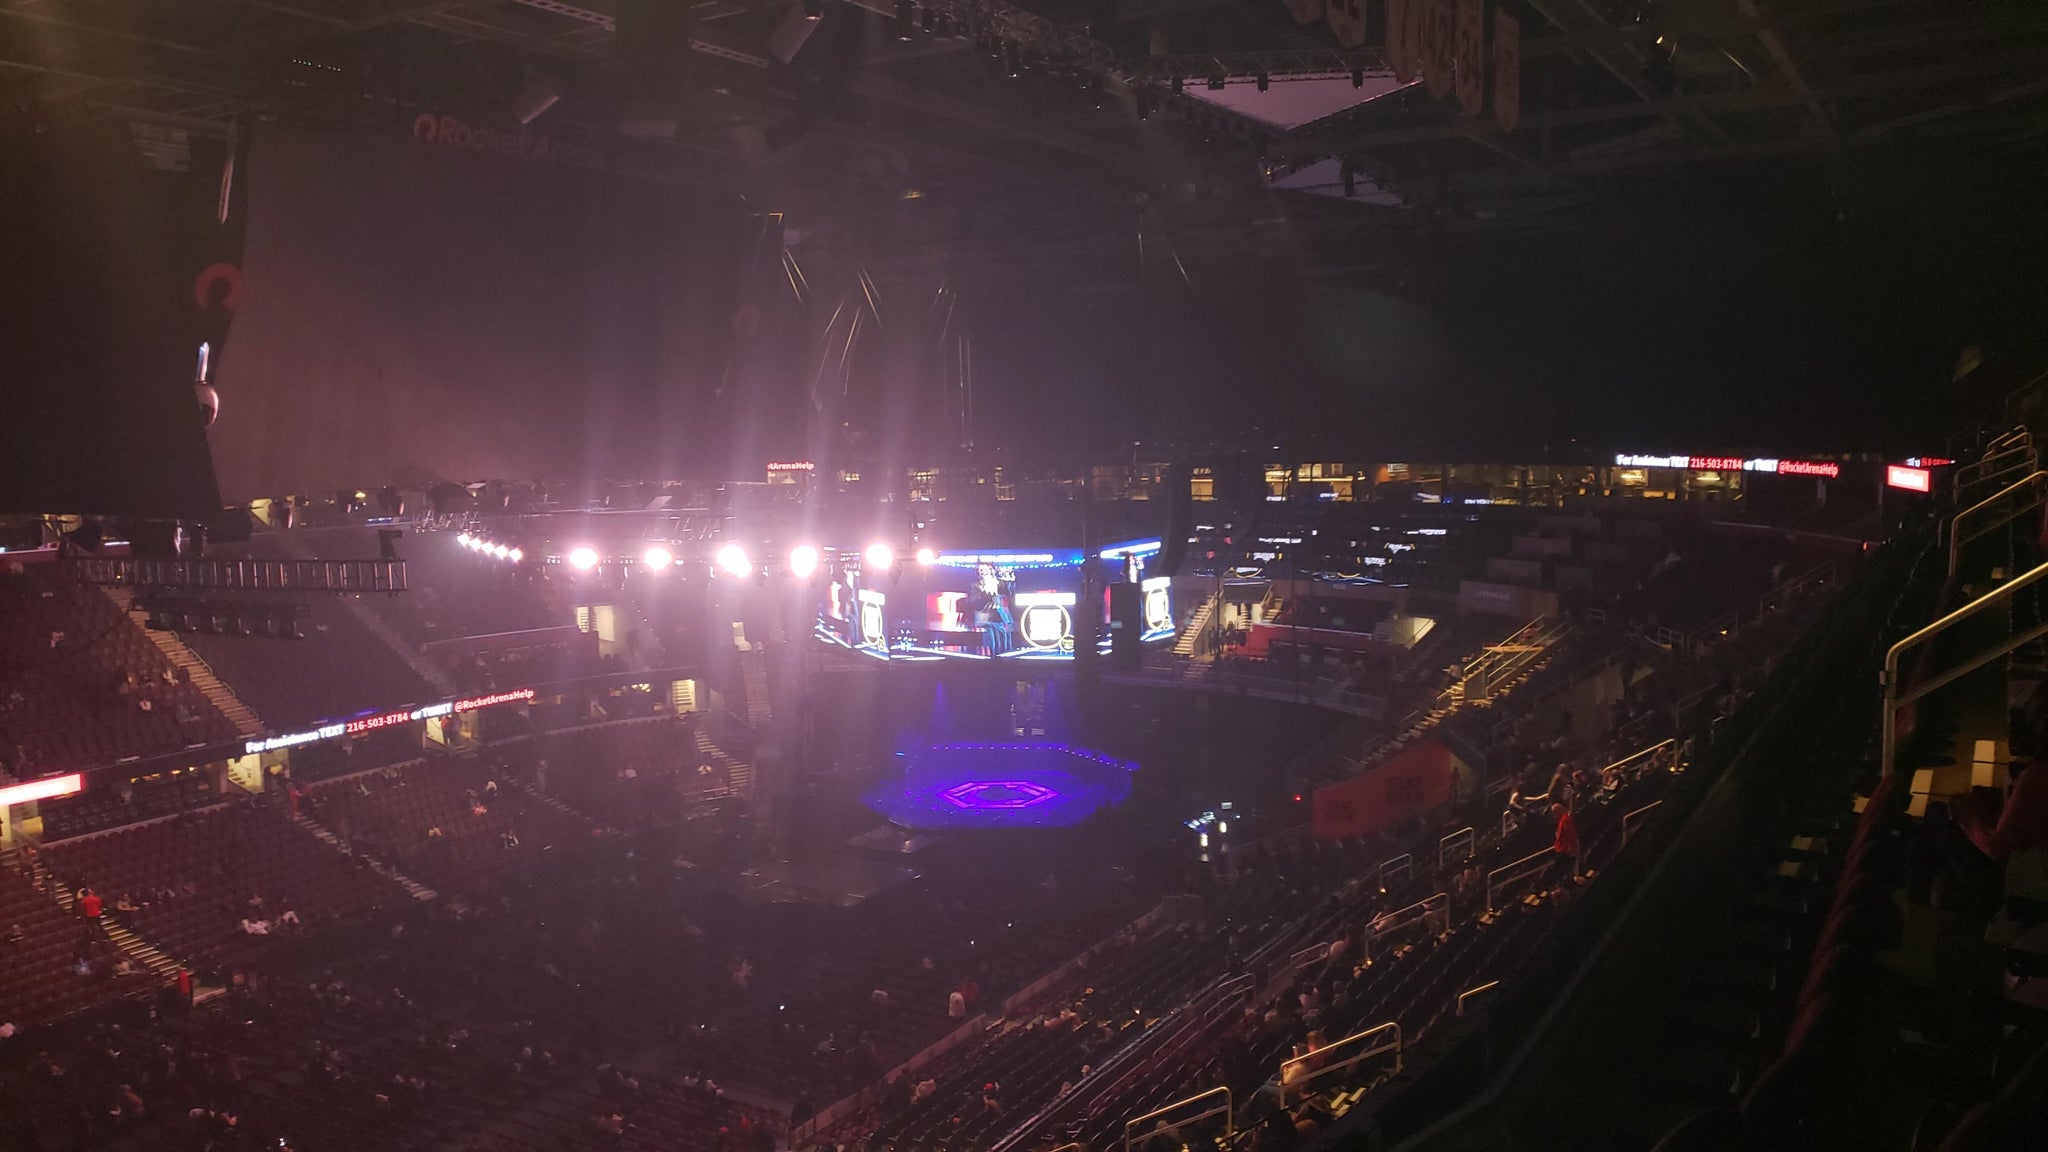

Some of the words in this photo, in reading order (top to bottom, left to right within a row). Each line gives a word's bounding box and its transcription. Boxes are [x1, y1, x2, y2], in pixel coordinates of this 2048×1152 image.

[1690, 457, 1742, 470] 216-503-8784
[1779, 460, 1838, 478] @RocketArenaHelp
[245, 741, 265, 754] For
[346, 712, 408, 733] 216-503-8784
[454, 689, 534, 713] @RocketArenaHelp
